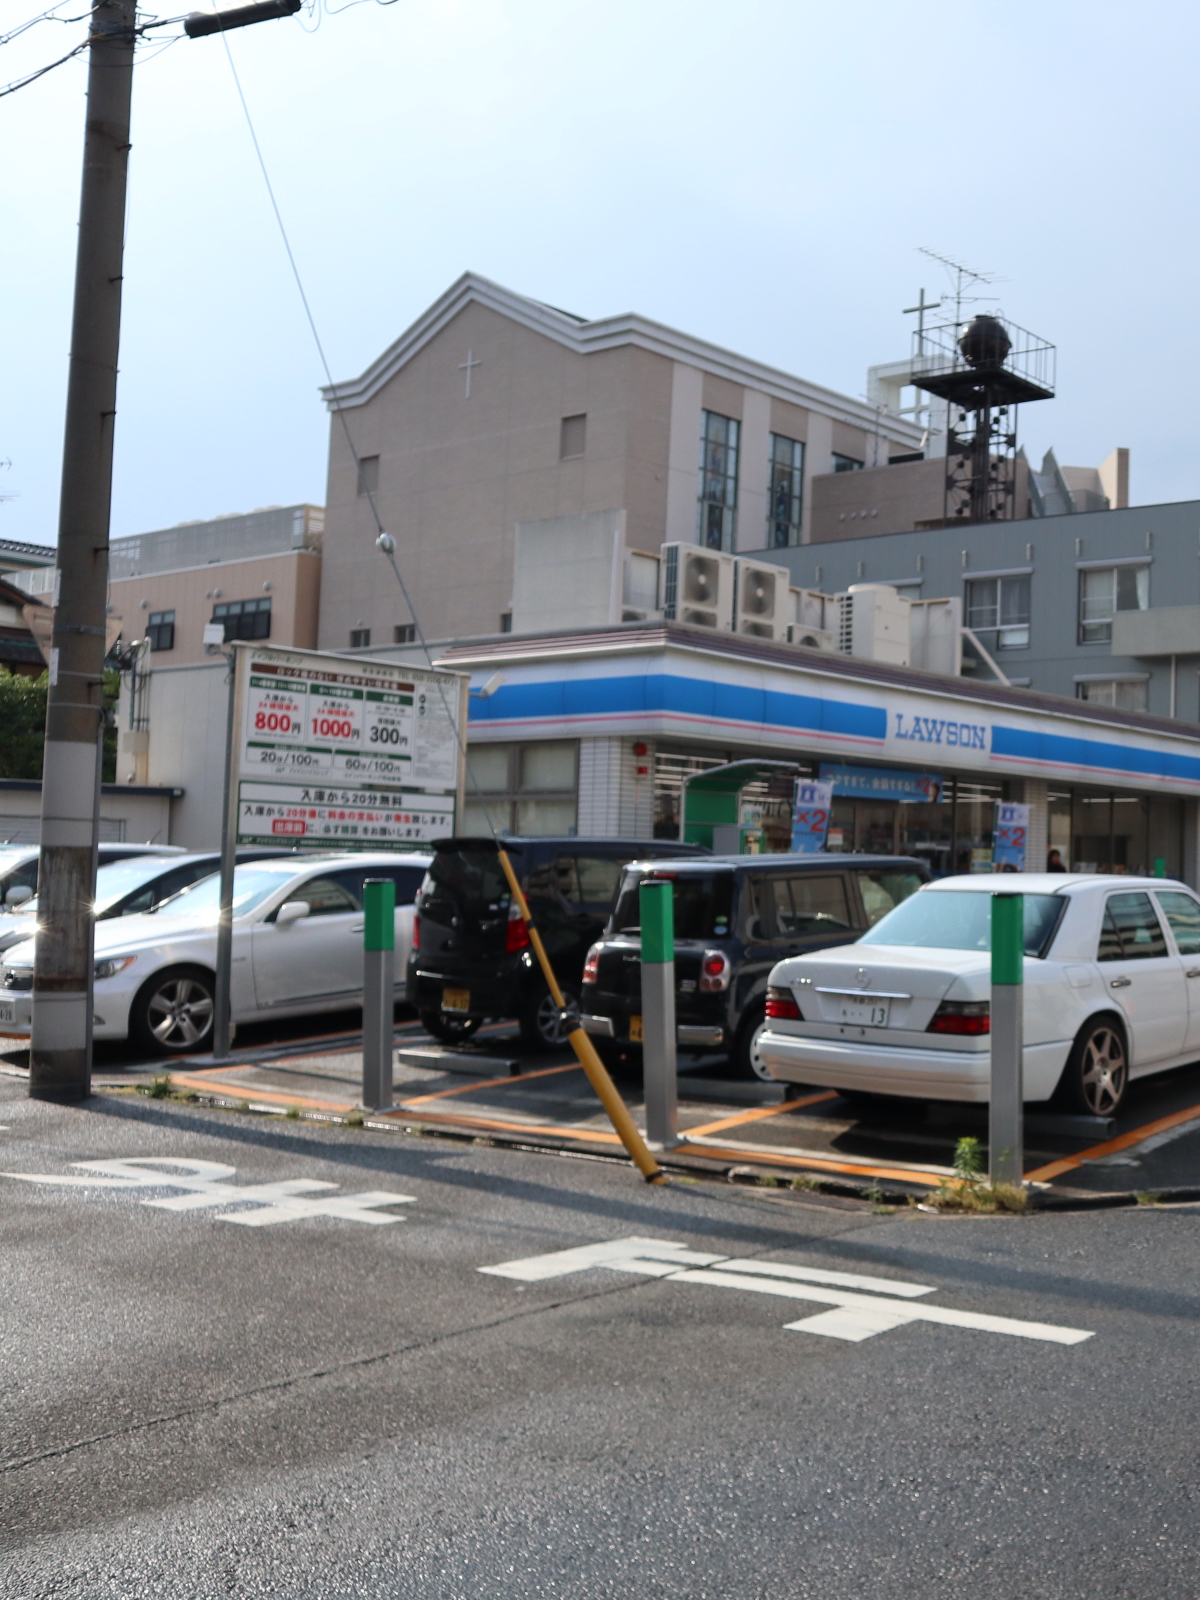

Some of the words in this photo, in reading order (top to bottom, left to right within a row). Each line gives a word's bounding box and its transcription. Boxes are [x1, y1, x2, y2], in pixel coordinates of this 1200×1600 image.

[254, 711, 301, 735] 800円
[311, 717, 360, 740] 1000円
[895, 713, 986, 750] LAWSON
[370, 725, 408, 747] 300円
[300, 789, 403, 807] 入庫から20分無料
